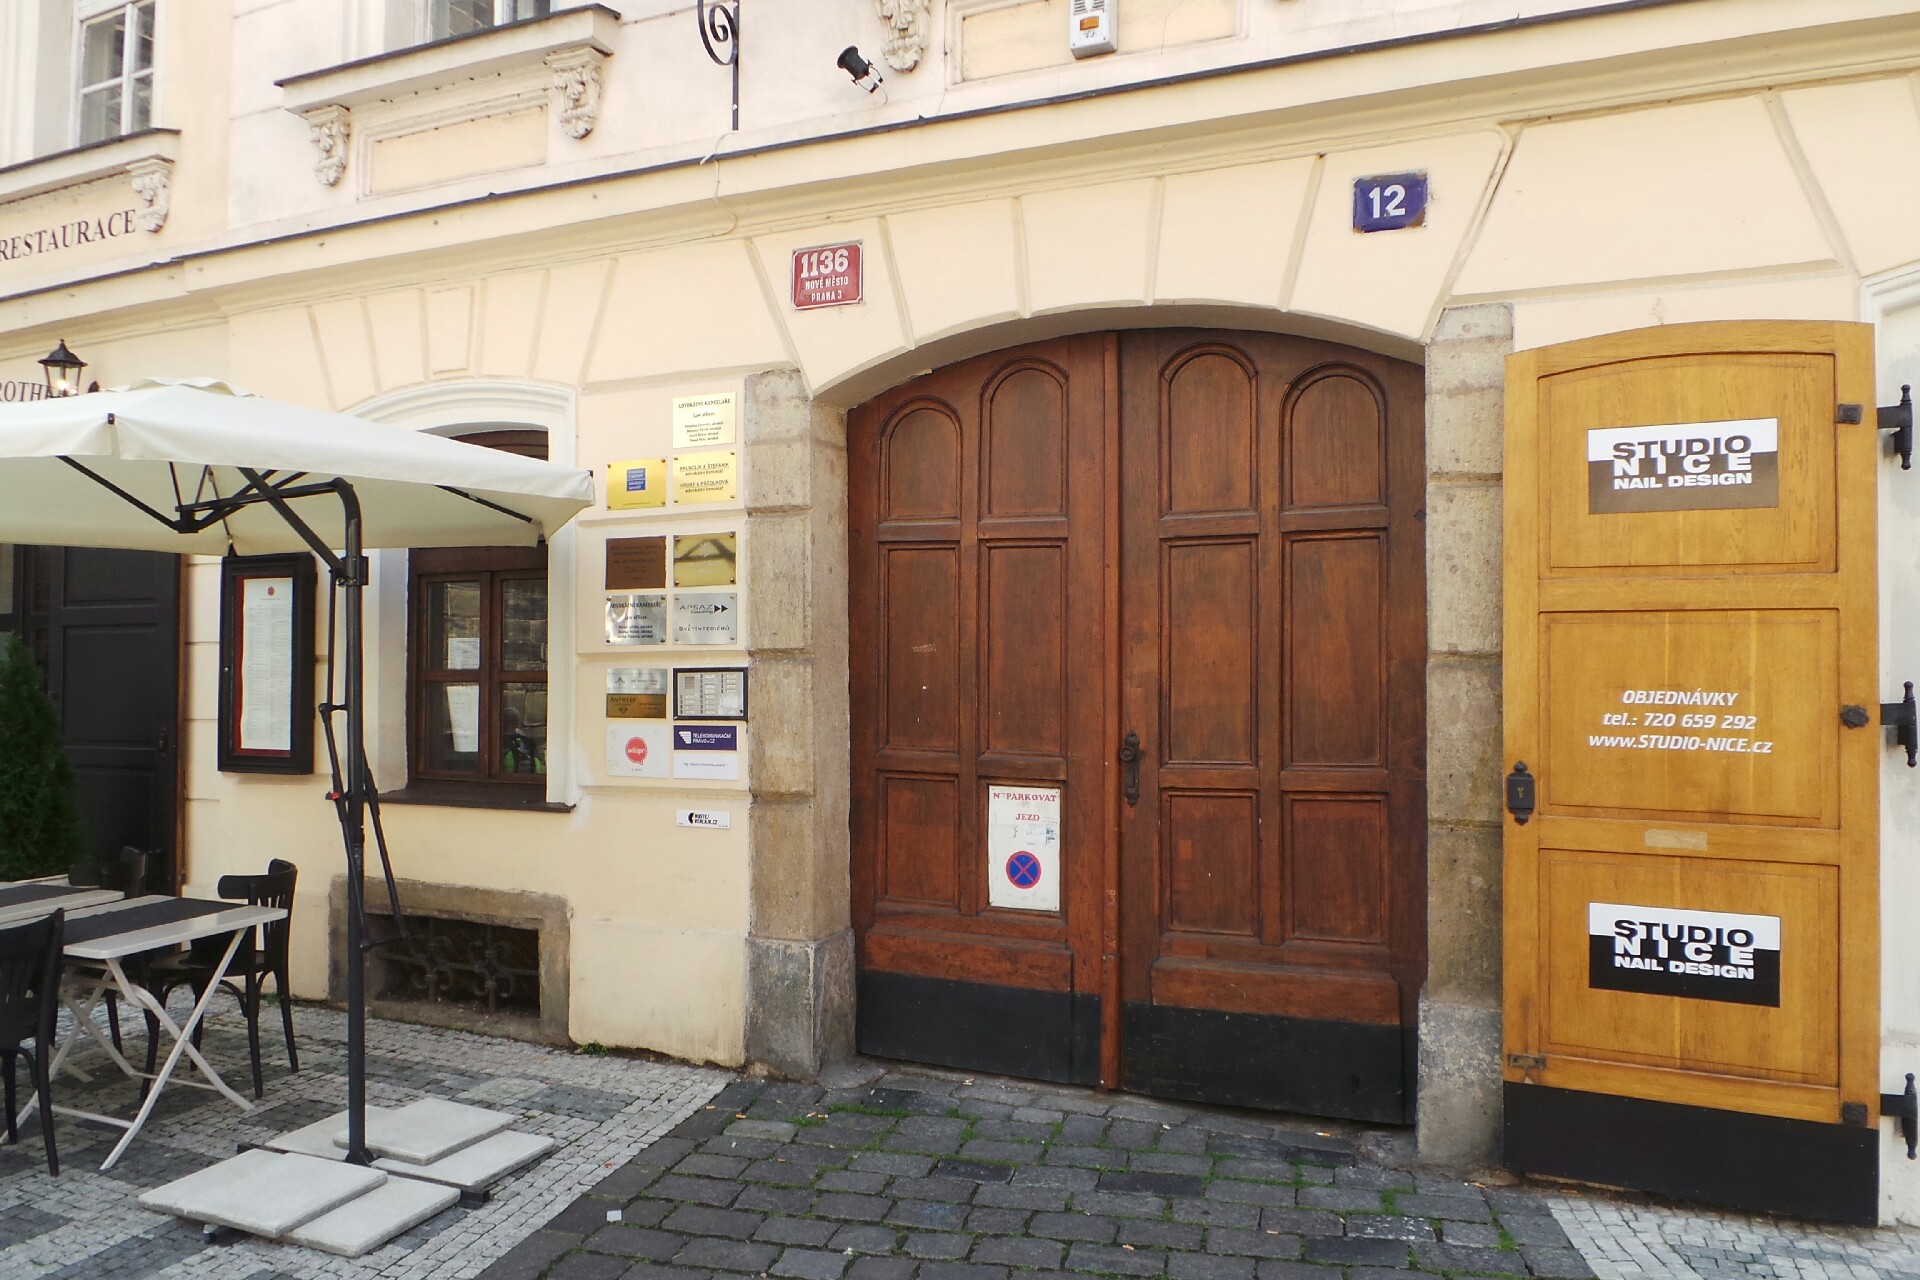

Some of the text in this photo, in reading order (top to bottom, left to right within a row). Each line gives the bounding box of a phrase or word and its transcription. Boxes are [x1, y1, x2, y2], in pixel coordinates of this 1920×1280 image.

[1368, 184, 1406, 219] 12
[0, 209, 136, 261] RESTAURACE
[801, 249, 848, 278] 1136
[805, 275, 848, 290] NOVÉ MĚSTO
[811, 290, 842, 302] PRAHA 3
[1612, 435, 1752, 460] STUDIO
[1614, 453, 1752, 477] NICE
[1614, 472, 1752, 490] NAIL DESIGN
[1622, 688, 1738, 706] OBJEDNÁVKY
[1603, 712, 1756, 730] tel.: 720 659 292
[1589, 734, 1773, 753] www.STUDIO-NICE.cz
[1614, 919, 1754, 948] STUDIO
[1614, 937, 1754, 966] NICE
[1615, 956, 1754, 980] NAIL DESIGN
